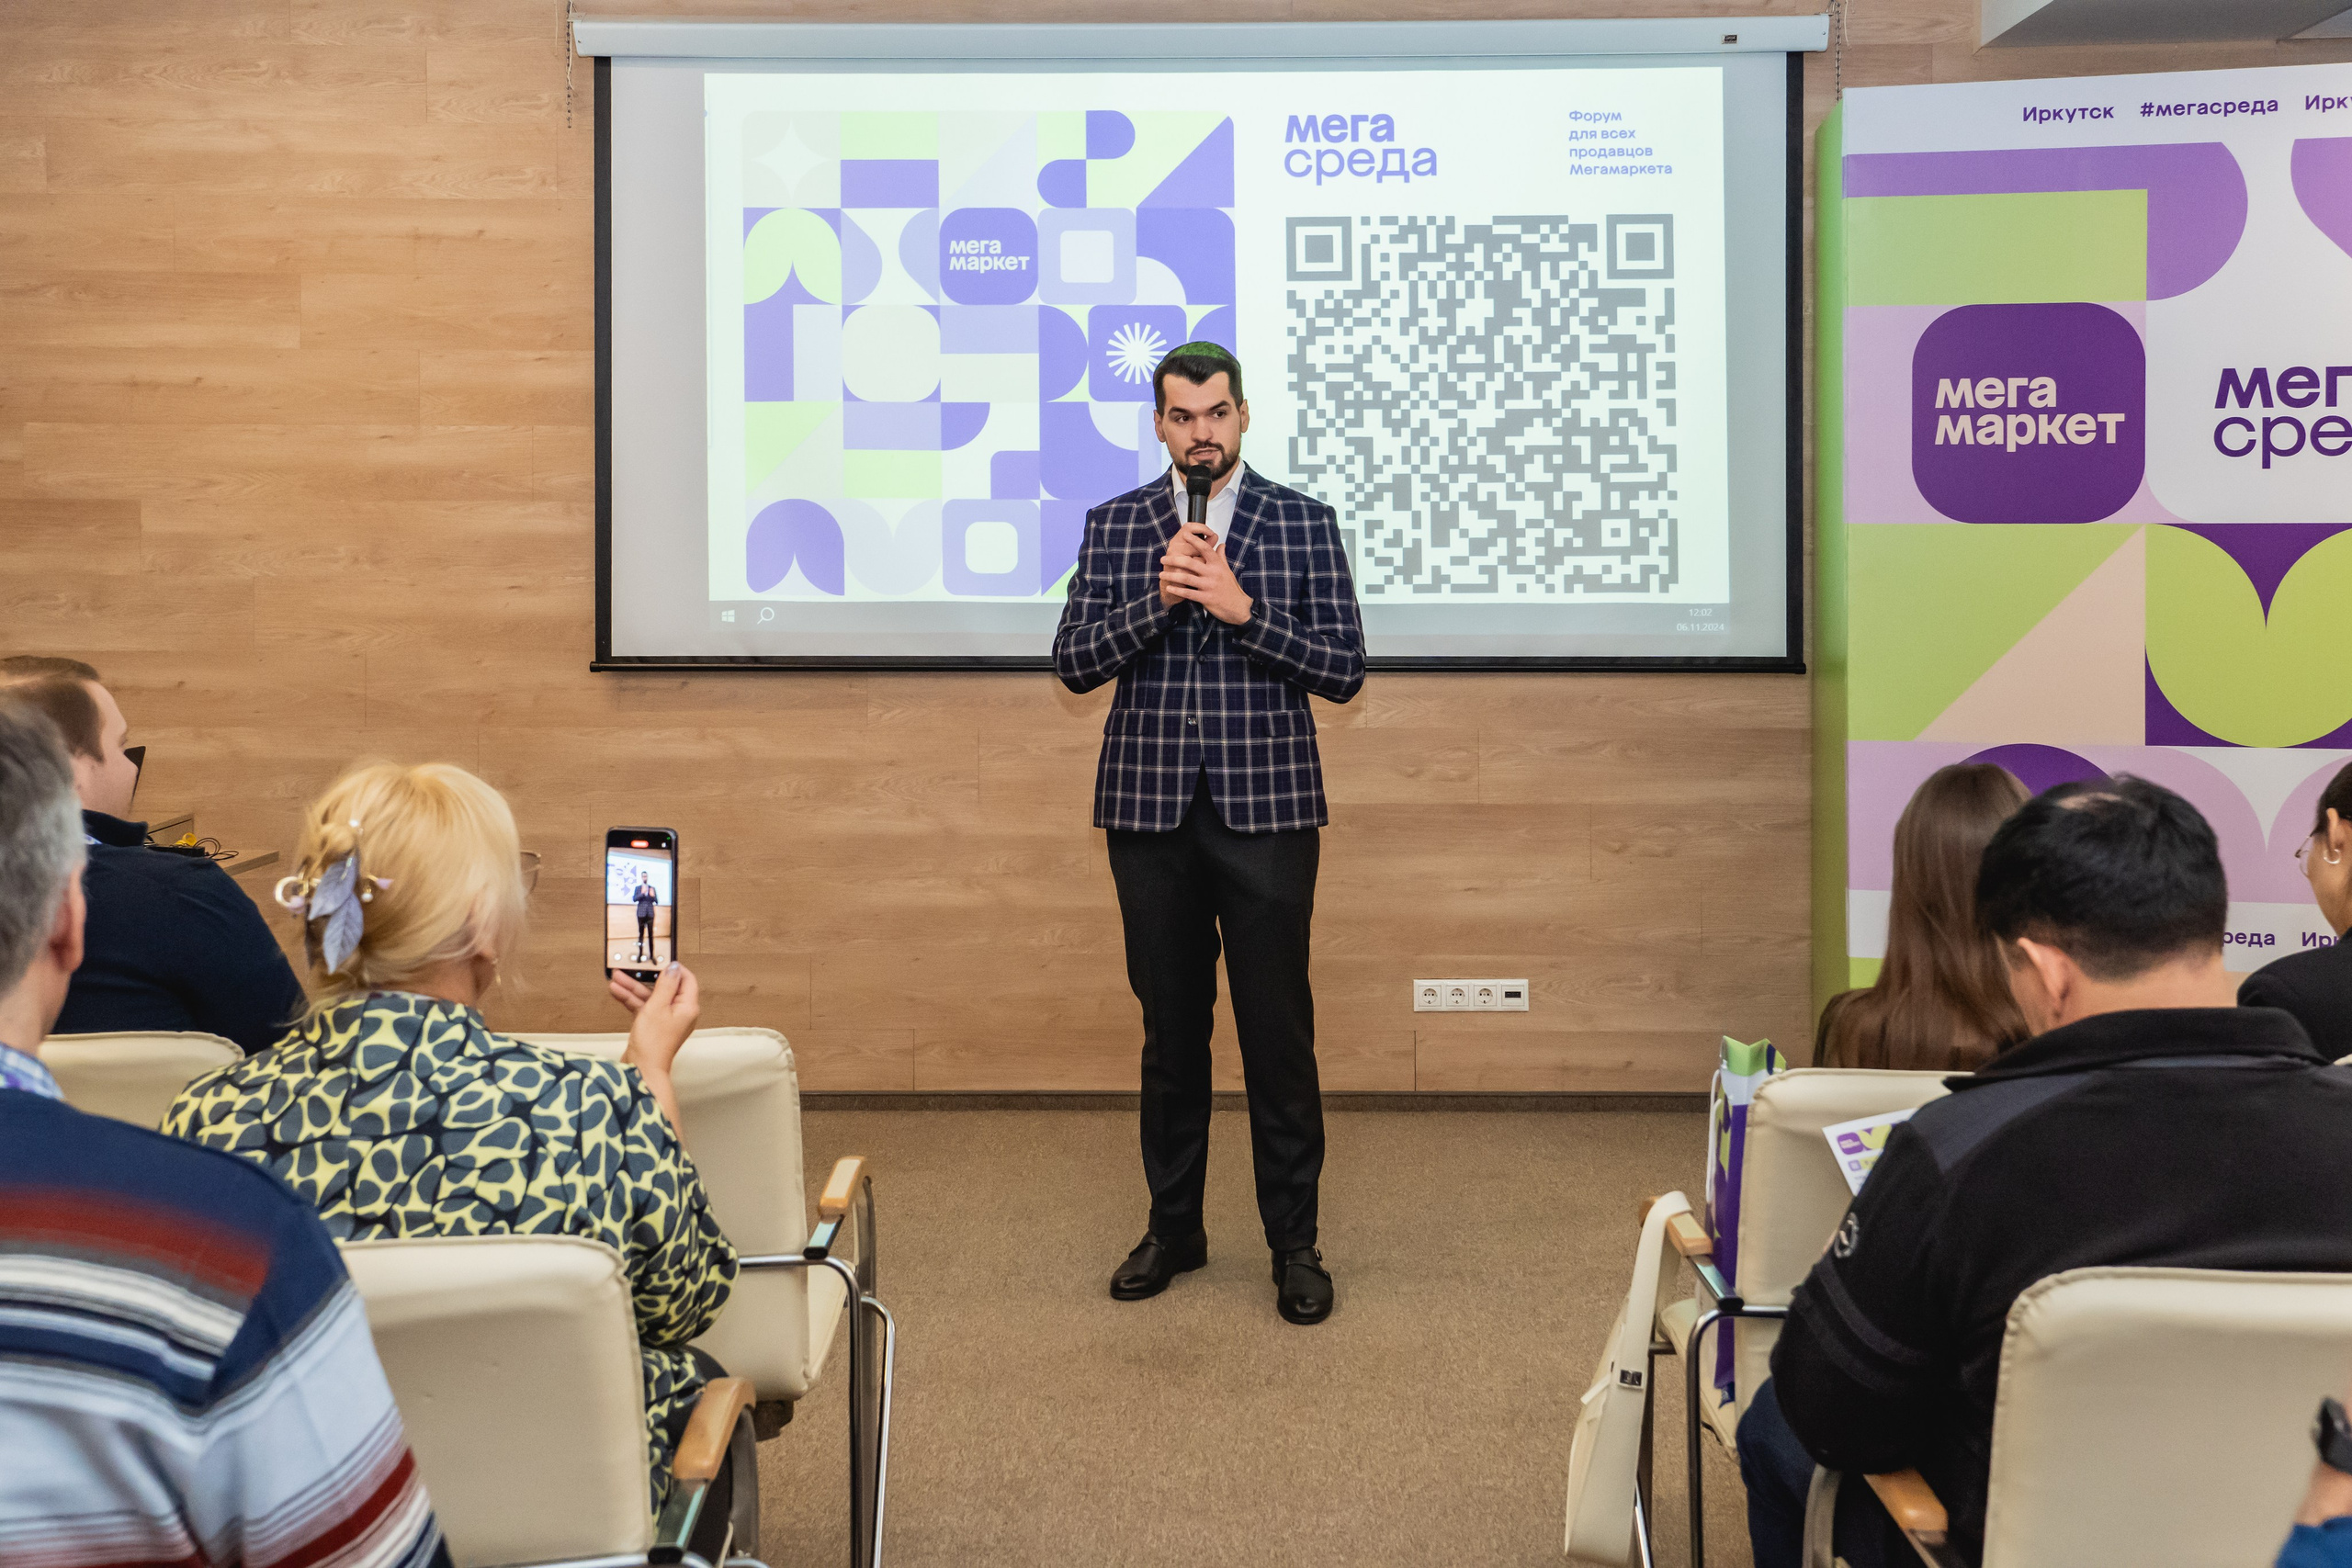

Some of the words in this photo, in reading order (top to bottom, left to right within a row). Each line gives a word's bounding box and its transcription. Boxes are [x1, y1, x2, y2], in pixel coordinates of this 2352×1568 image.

[1568, 110, 1623, 124] Форум
[2023, 106, 2115, 124] Иркутск
[2140, 99, 2278, 118] #мегасреда
[2305, 95, 2352, 113] Ирк
[1284, 113, 1396, 144] мега
[1568, 130, 1598, 141] для
[1600, 130, 1636, 140] всех
[1569, 147, 1654, 160] продавцов
[1283, 147, 1438, 186] среда
[1569, 164, 1673, 177] Мегамаркета
[949, 240, 1001, 254] мега
[949, 255, 1031, 274] маркет
[1934, 376, 2057, 409] мега
[1934, 412, 2125, 453] маркет
[1676, 623, 1724, 632] 06.11.2024
